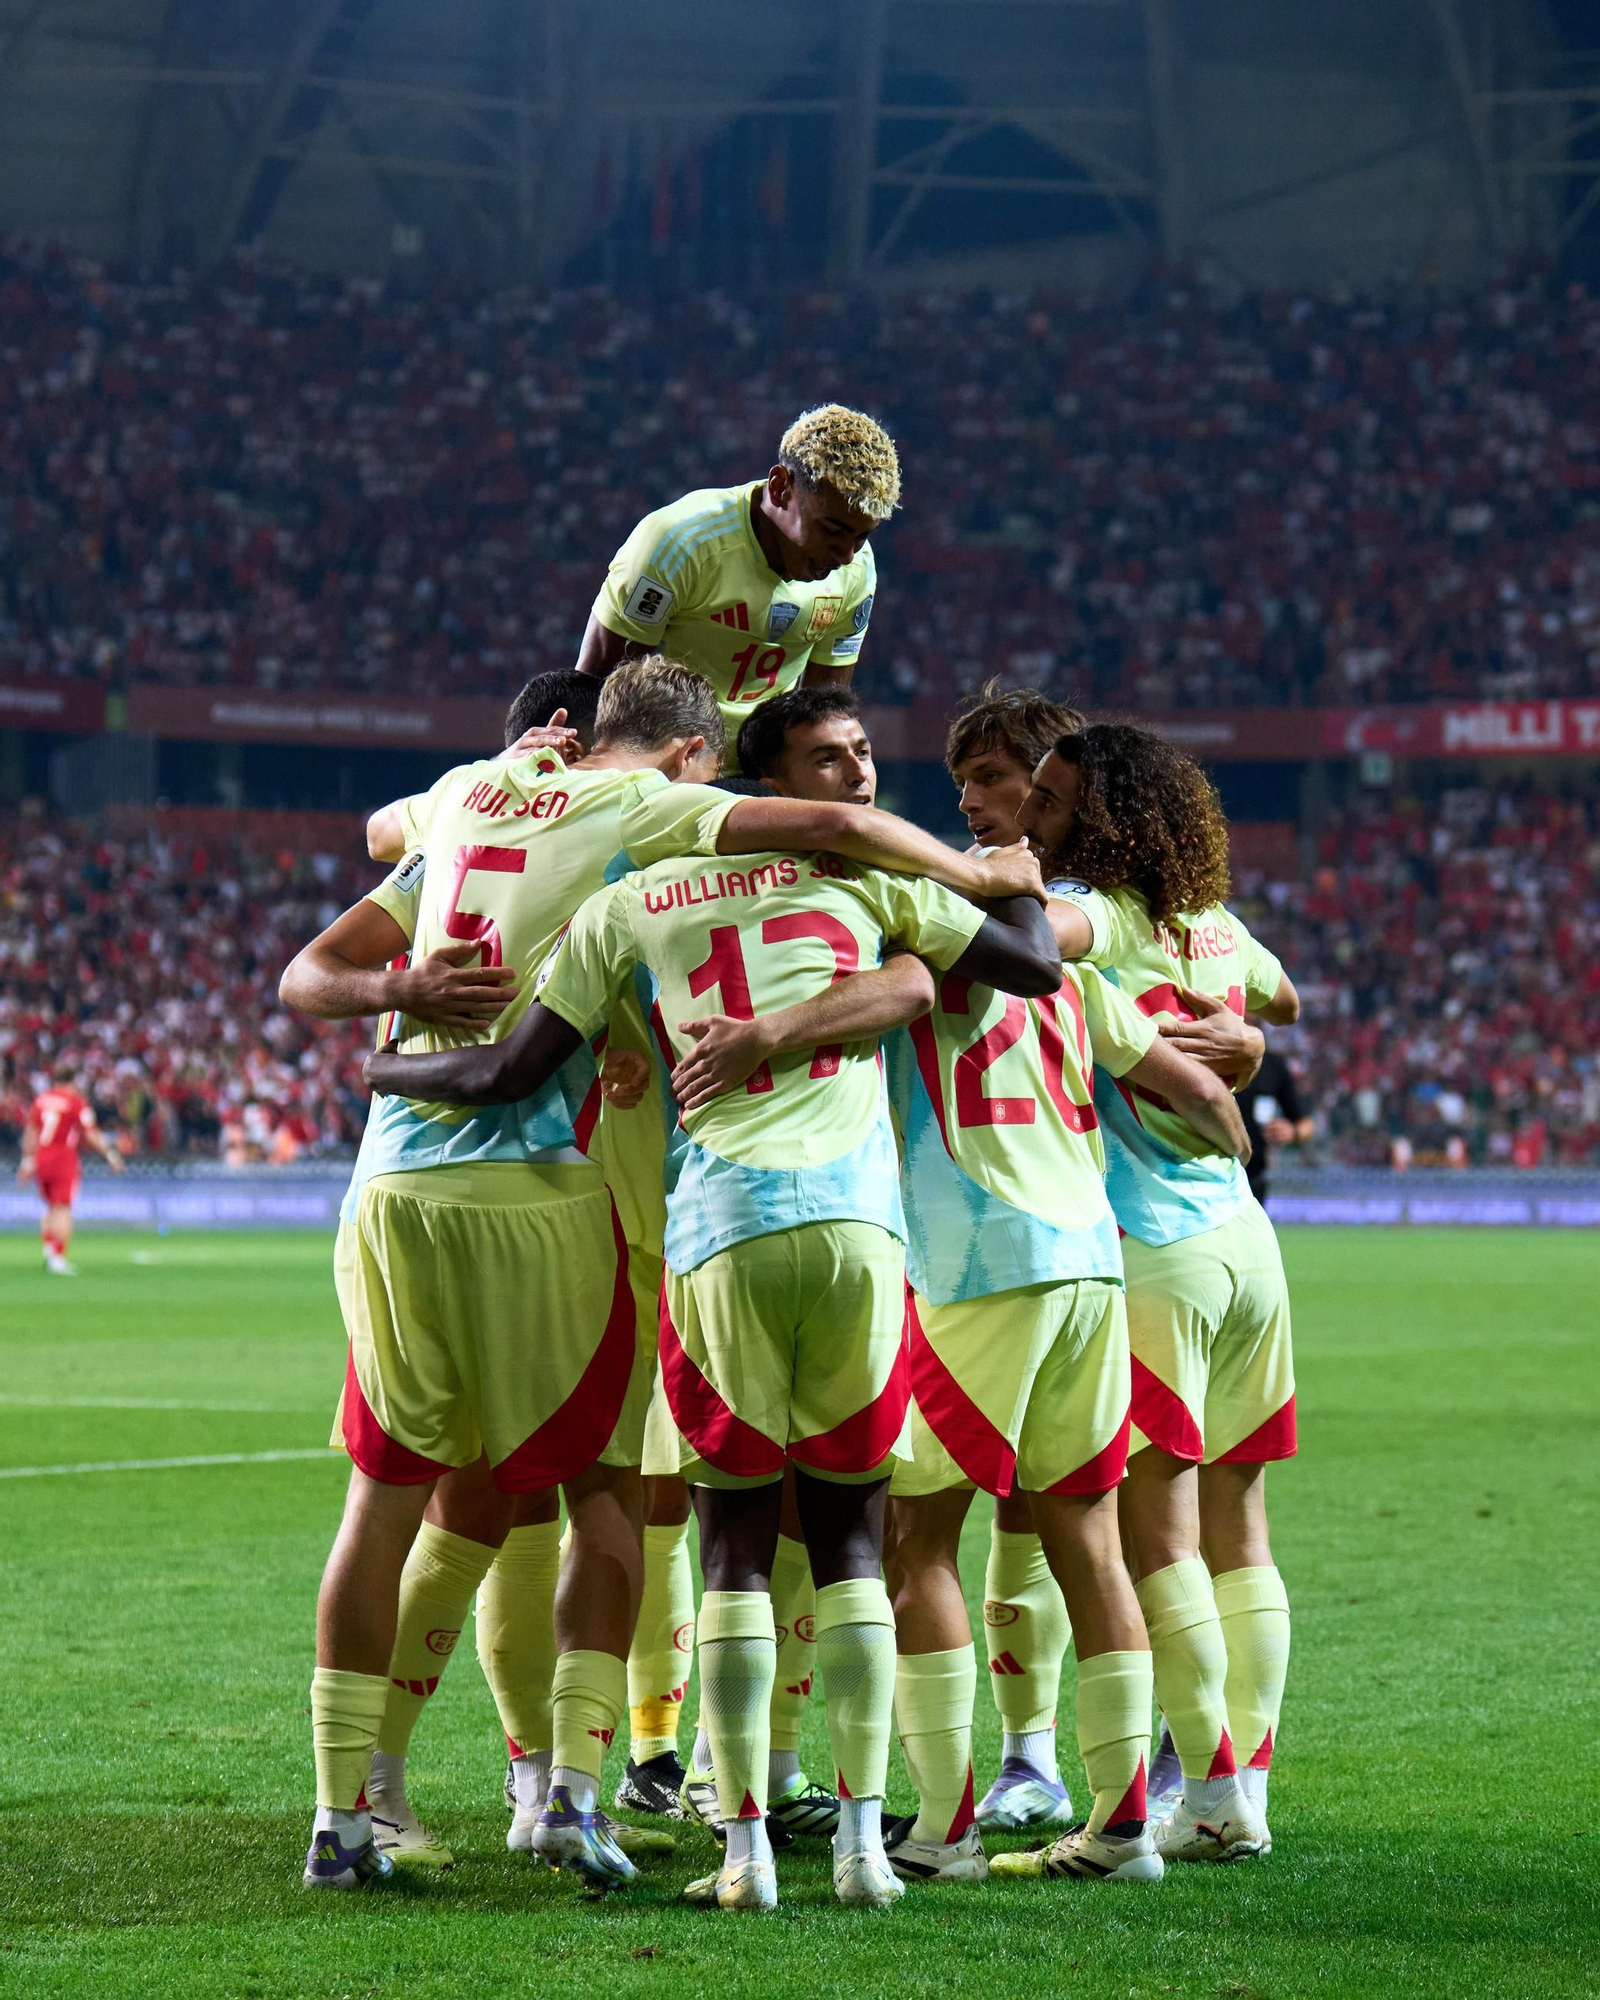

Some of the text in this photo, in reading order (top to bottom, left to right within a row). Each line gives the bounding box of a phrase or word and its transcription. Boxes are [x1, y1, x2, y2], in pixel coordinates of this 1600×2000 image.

[727, 643, 786, 702] 19
[462, 780, 570, 819] HUISEN
[443, 844, 528, 987] 5
[644, 855, 859, 914] WILLIAMS JR.
[687, 910, 860, 1094] 17
[940, 972, 1100, 1135] 20
